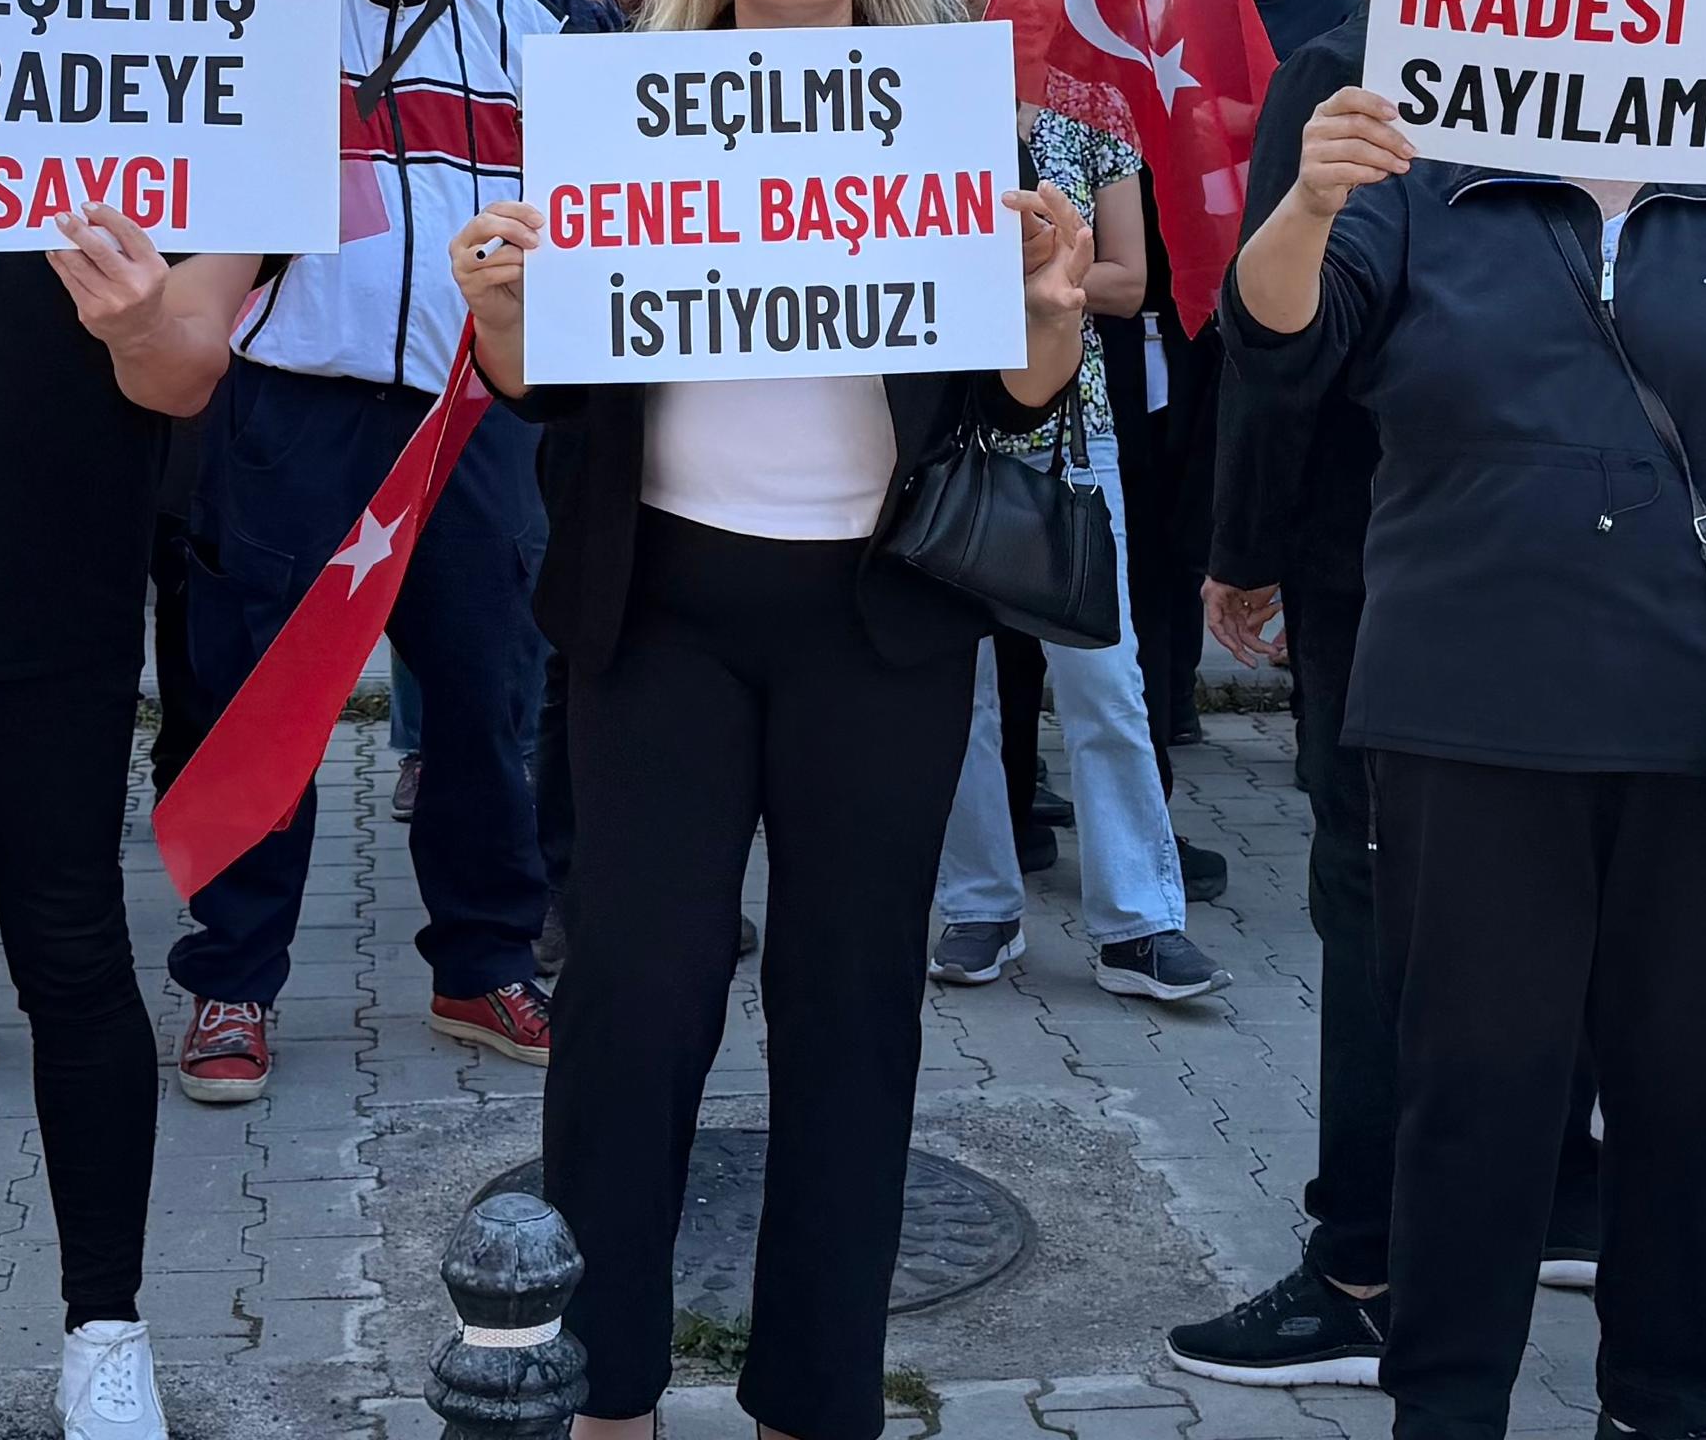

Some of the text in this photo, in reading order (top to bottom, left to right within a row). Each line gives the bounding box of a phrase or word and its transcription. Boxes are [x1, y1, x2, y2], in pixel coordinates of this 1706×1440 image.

[637, 50, 901, 151] SEÇİLMİŞ
[550, 171, 993, 255] GENEL BAŞKAN
[611, 269, 937, 356] İSTİYORUZ!
